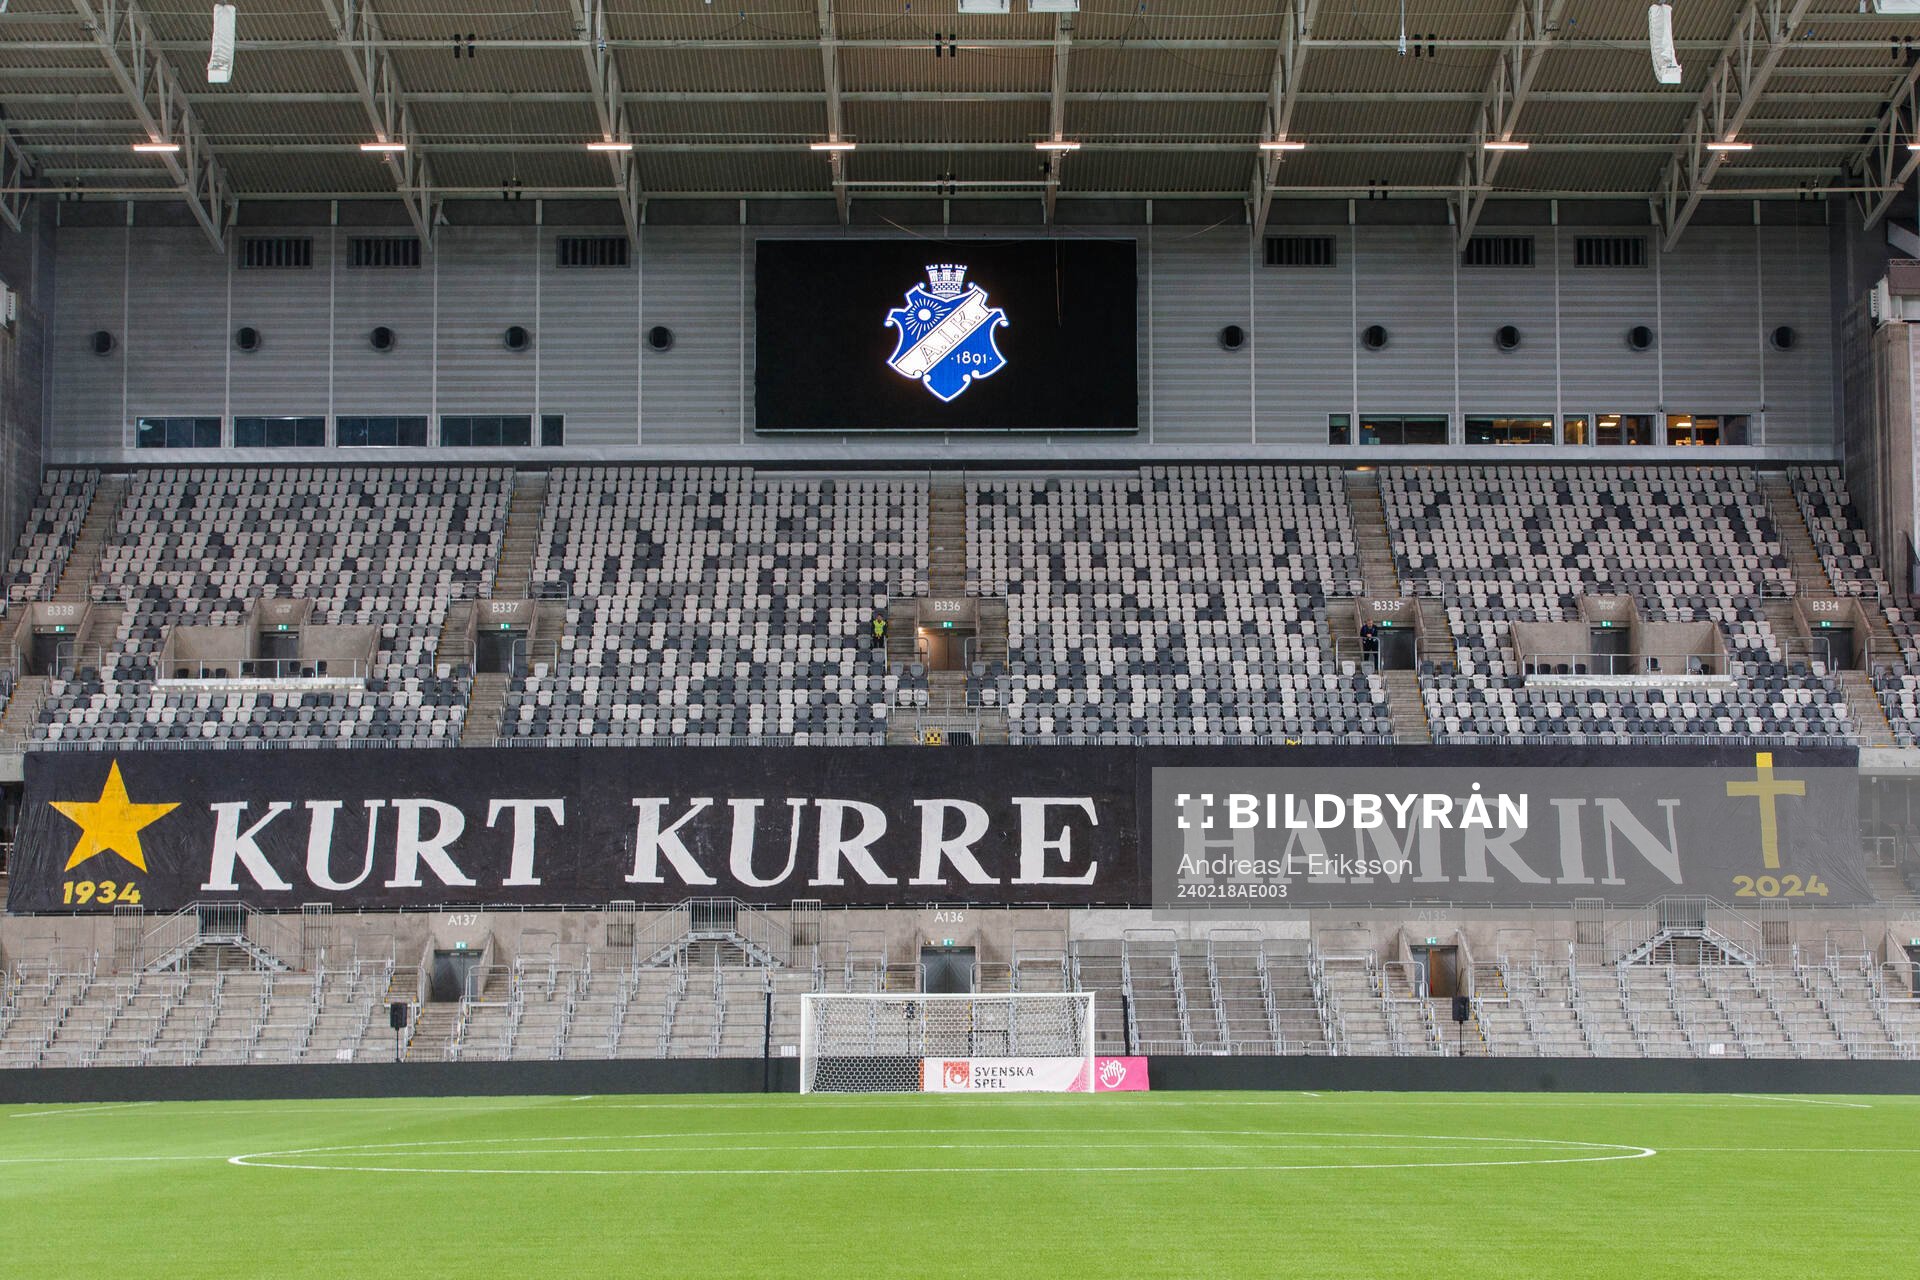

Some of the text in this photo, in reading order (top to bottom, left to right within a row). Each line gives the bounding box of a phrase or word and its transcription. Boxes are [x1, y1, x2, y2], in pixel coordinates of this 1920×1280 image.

[492, 602, 519, 613] B337
[934, 600, 961, 611] B336
[1374, 600, 1400, 611] B335
[1812, 600, 1839, 611] B334
[201, 797, 1682, 890] KURT KURRE HAMRIN
[1732, 875, 1829, 898] 2024
[63, 880, 141, 905] 1934
[447, 914, 477, 926] A137
[934, 911, 964, 923] A136
[1418, 910, 1447, 921] A135
[974, 1067, 1034, 1077] SVENSKA
[974, 1079, 1005, 1088] SPEL
